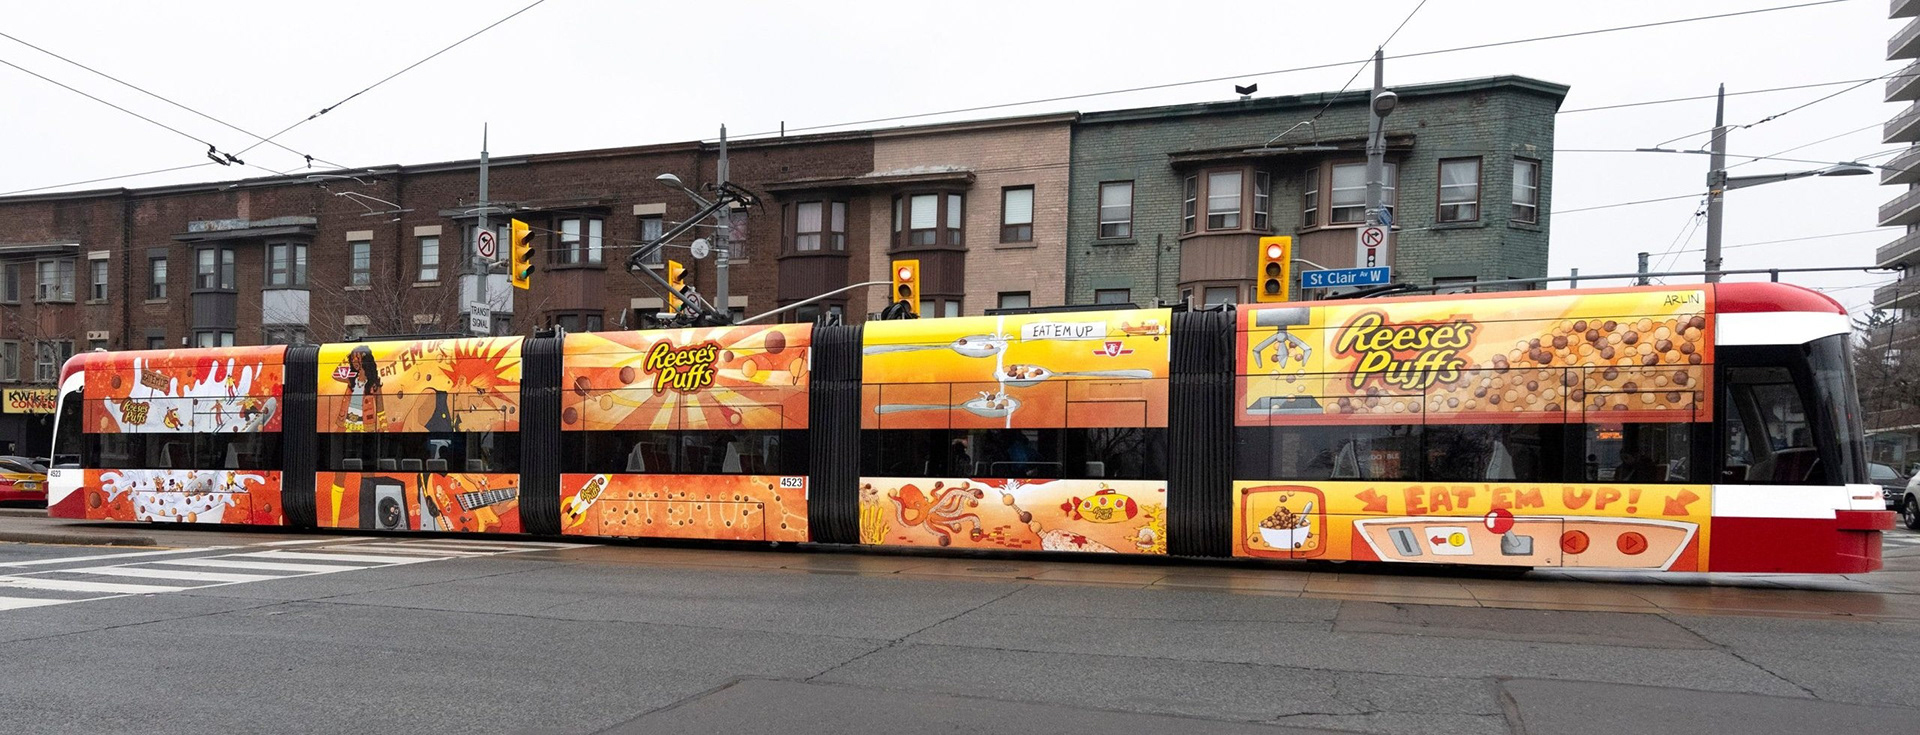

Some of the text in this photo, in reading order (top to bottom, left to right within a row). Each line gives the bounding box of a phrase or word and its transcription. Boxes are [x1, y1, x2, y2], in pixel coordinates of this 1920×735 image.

[1310, 273, 1322, 285] St
[1327, 271, 1356, 284] Clair
[1370, 270, 1381, 282] W
[1663, 293, 1700, 306] ARLIN
[471, 305, 490, 317] TRANSIT
[472, 317, 488, 329] SIGNAL
[1032, 325, 1051, 337] EAT
[1075, 325, 1094, 338] UP
[1336, 312, 1475, 353] Reese's
[646, 342, 718, 371] Reese's
[380, 361, 397, 377] EAT
[1353, 349, 1467, 389] Puffs
[656, 363, 714, 392] Puffs
[780, 477, 803, 487] 4523
[1403, 486, 1476, 516] EAT
[1561, 486, 1643, 514] UP!
[600, 491, 660, 526] EAT
[719, 493, 765, 529] UP
